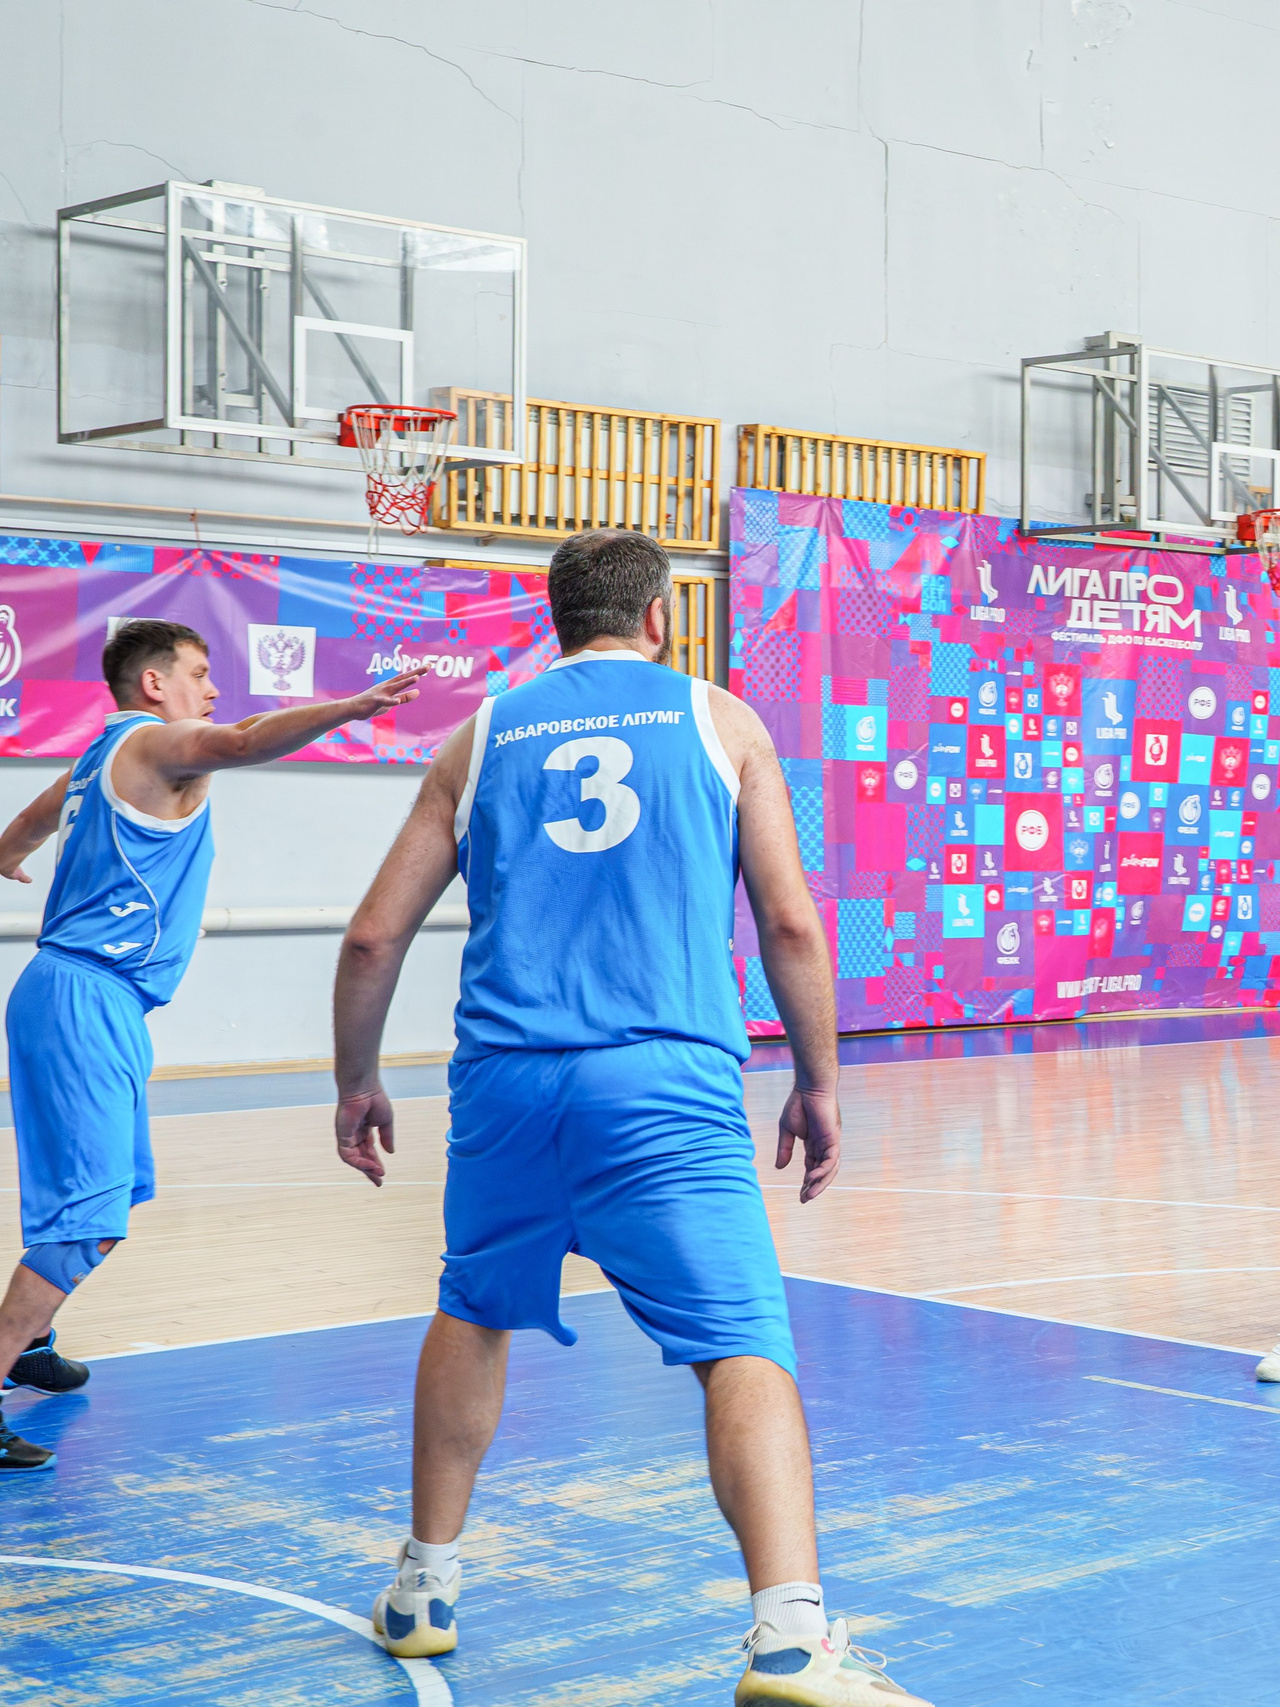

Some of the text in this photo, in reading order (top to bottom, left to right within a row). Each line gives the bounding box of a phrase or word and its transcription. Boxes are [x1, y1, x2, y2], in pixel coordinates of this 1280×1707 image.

[1067, 599, 1202, 638] ДЕТЯМ
[494, 710, 685, 748] ХАБАРОВСКОЕ ЛПУМГ
[543, 736, 641, 853] 3
